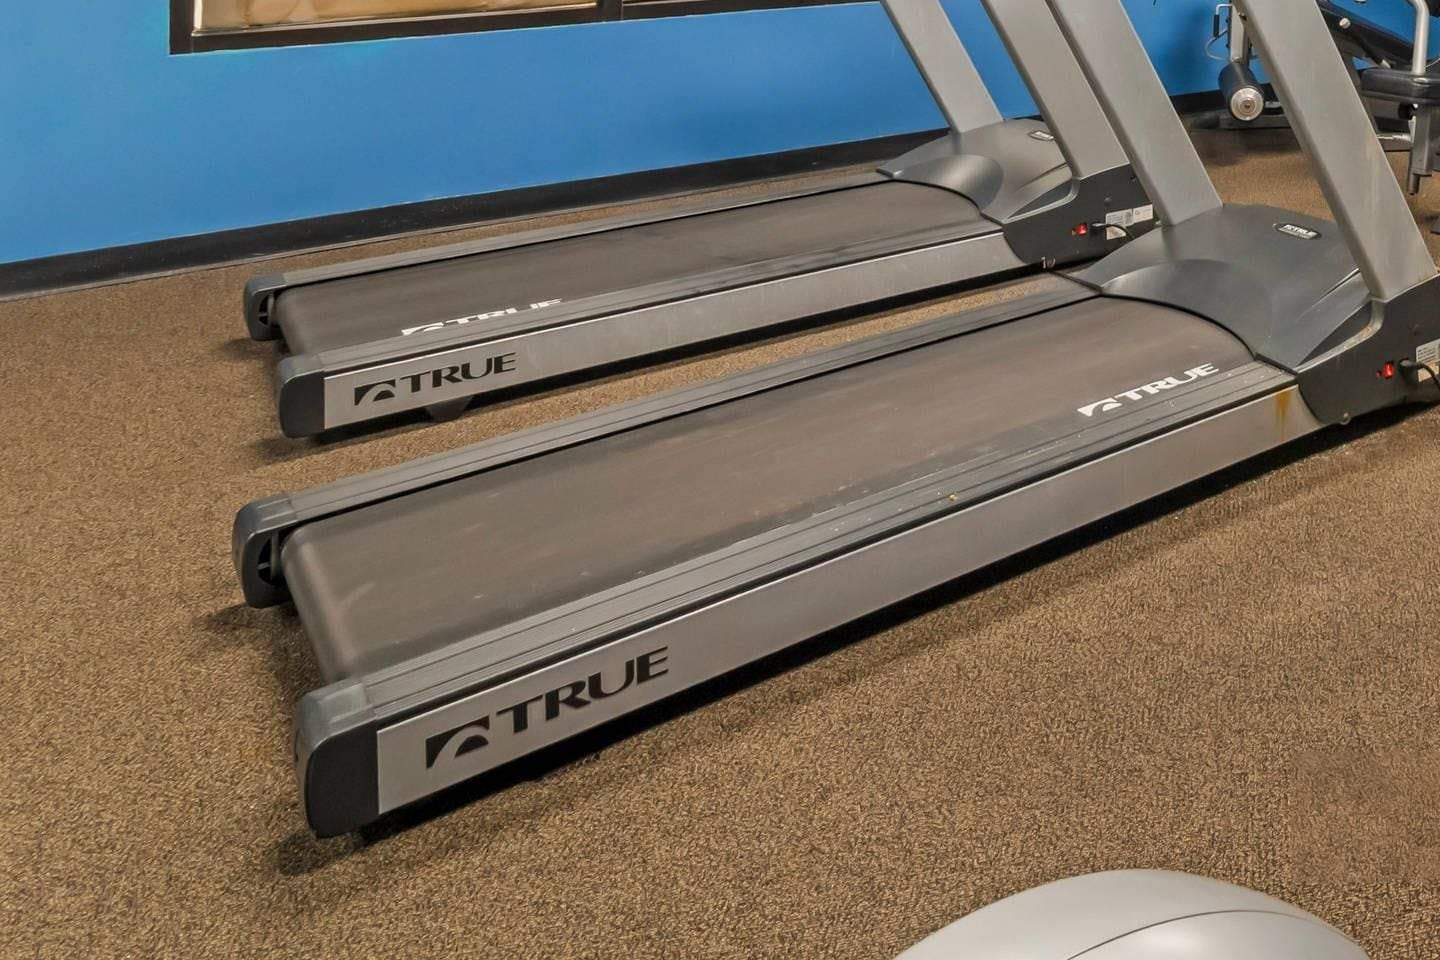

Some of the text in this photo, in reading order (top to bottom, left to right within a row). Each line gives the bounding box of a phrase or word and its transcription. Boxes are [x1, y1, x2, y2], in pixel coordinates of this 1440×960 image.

[400, 351, 516, 393] TRUE
[1114, 362, 1219, 401] TRUE
[496, 646, 669, 734] TRUE
